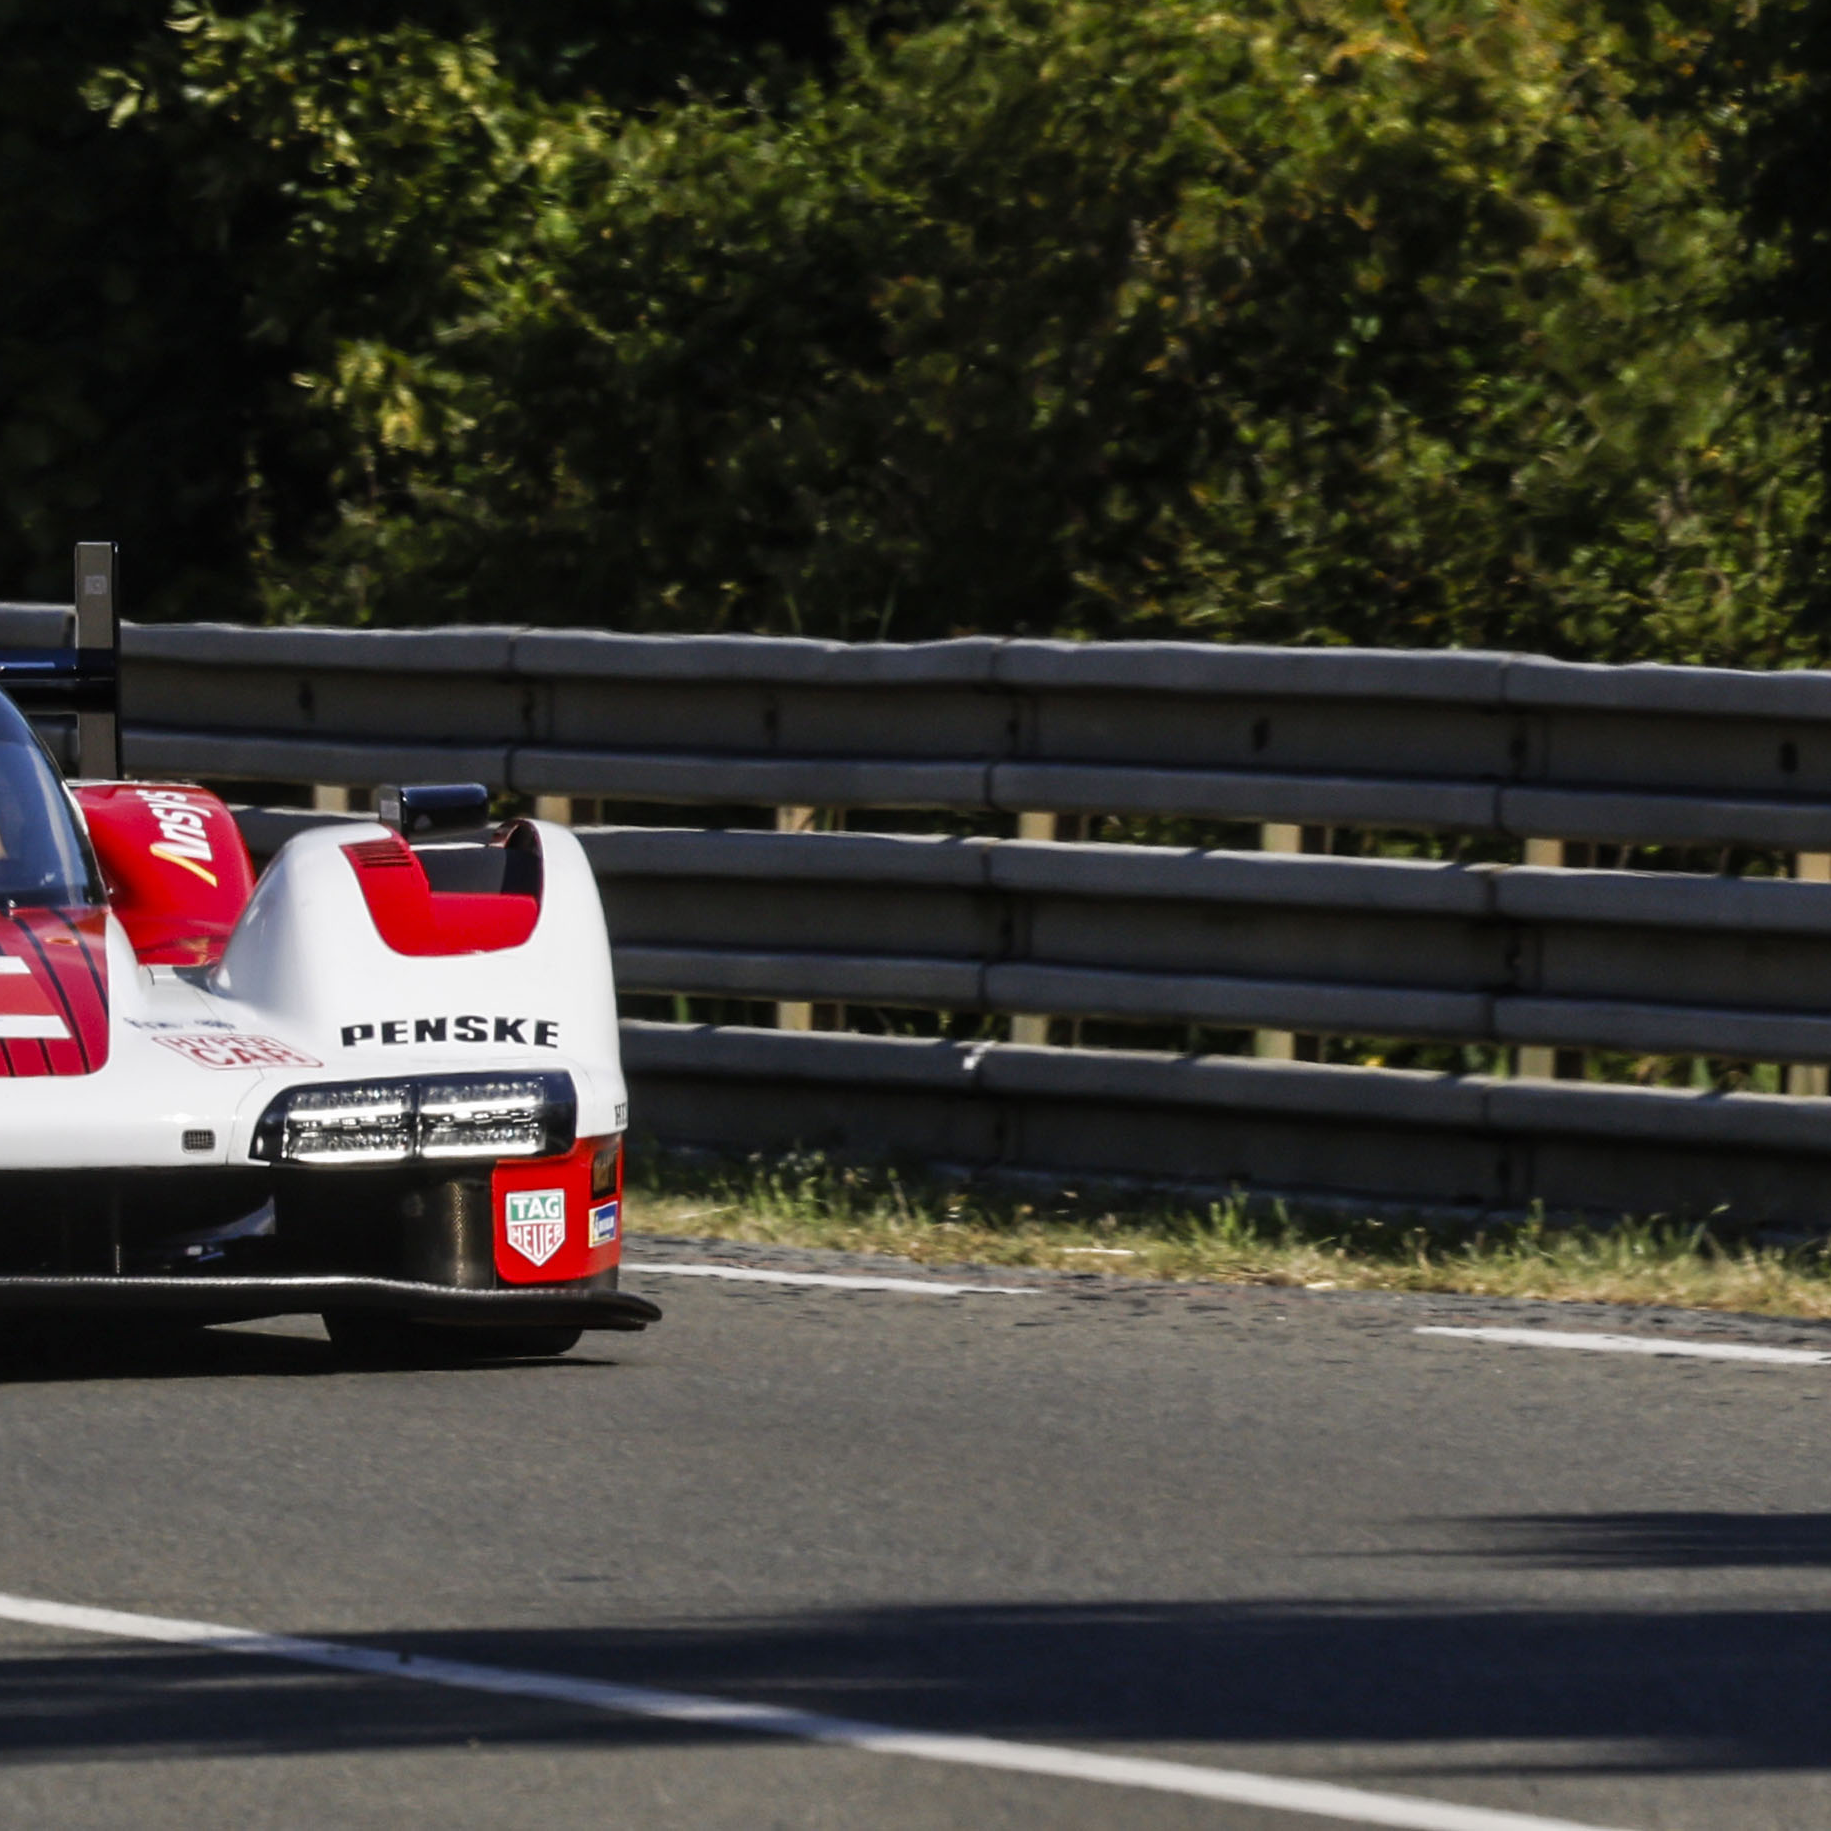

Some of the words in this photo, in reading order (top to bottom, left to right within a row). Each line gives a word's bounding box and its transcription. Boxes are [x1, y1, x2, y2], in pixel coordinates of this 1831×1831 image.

[340, 1015, 559, 1050] PENSKE
[512, 1194, 561, 1220] TAG
[511, 1225, 563, 1259] HEUER
